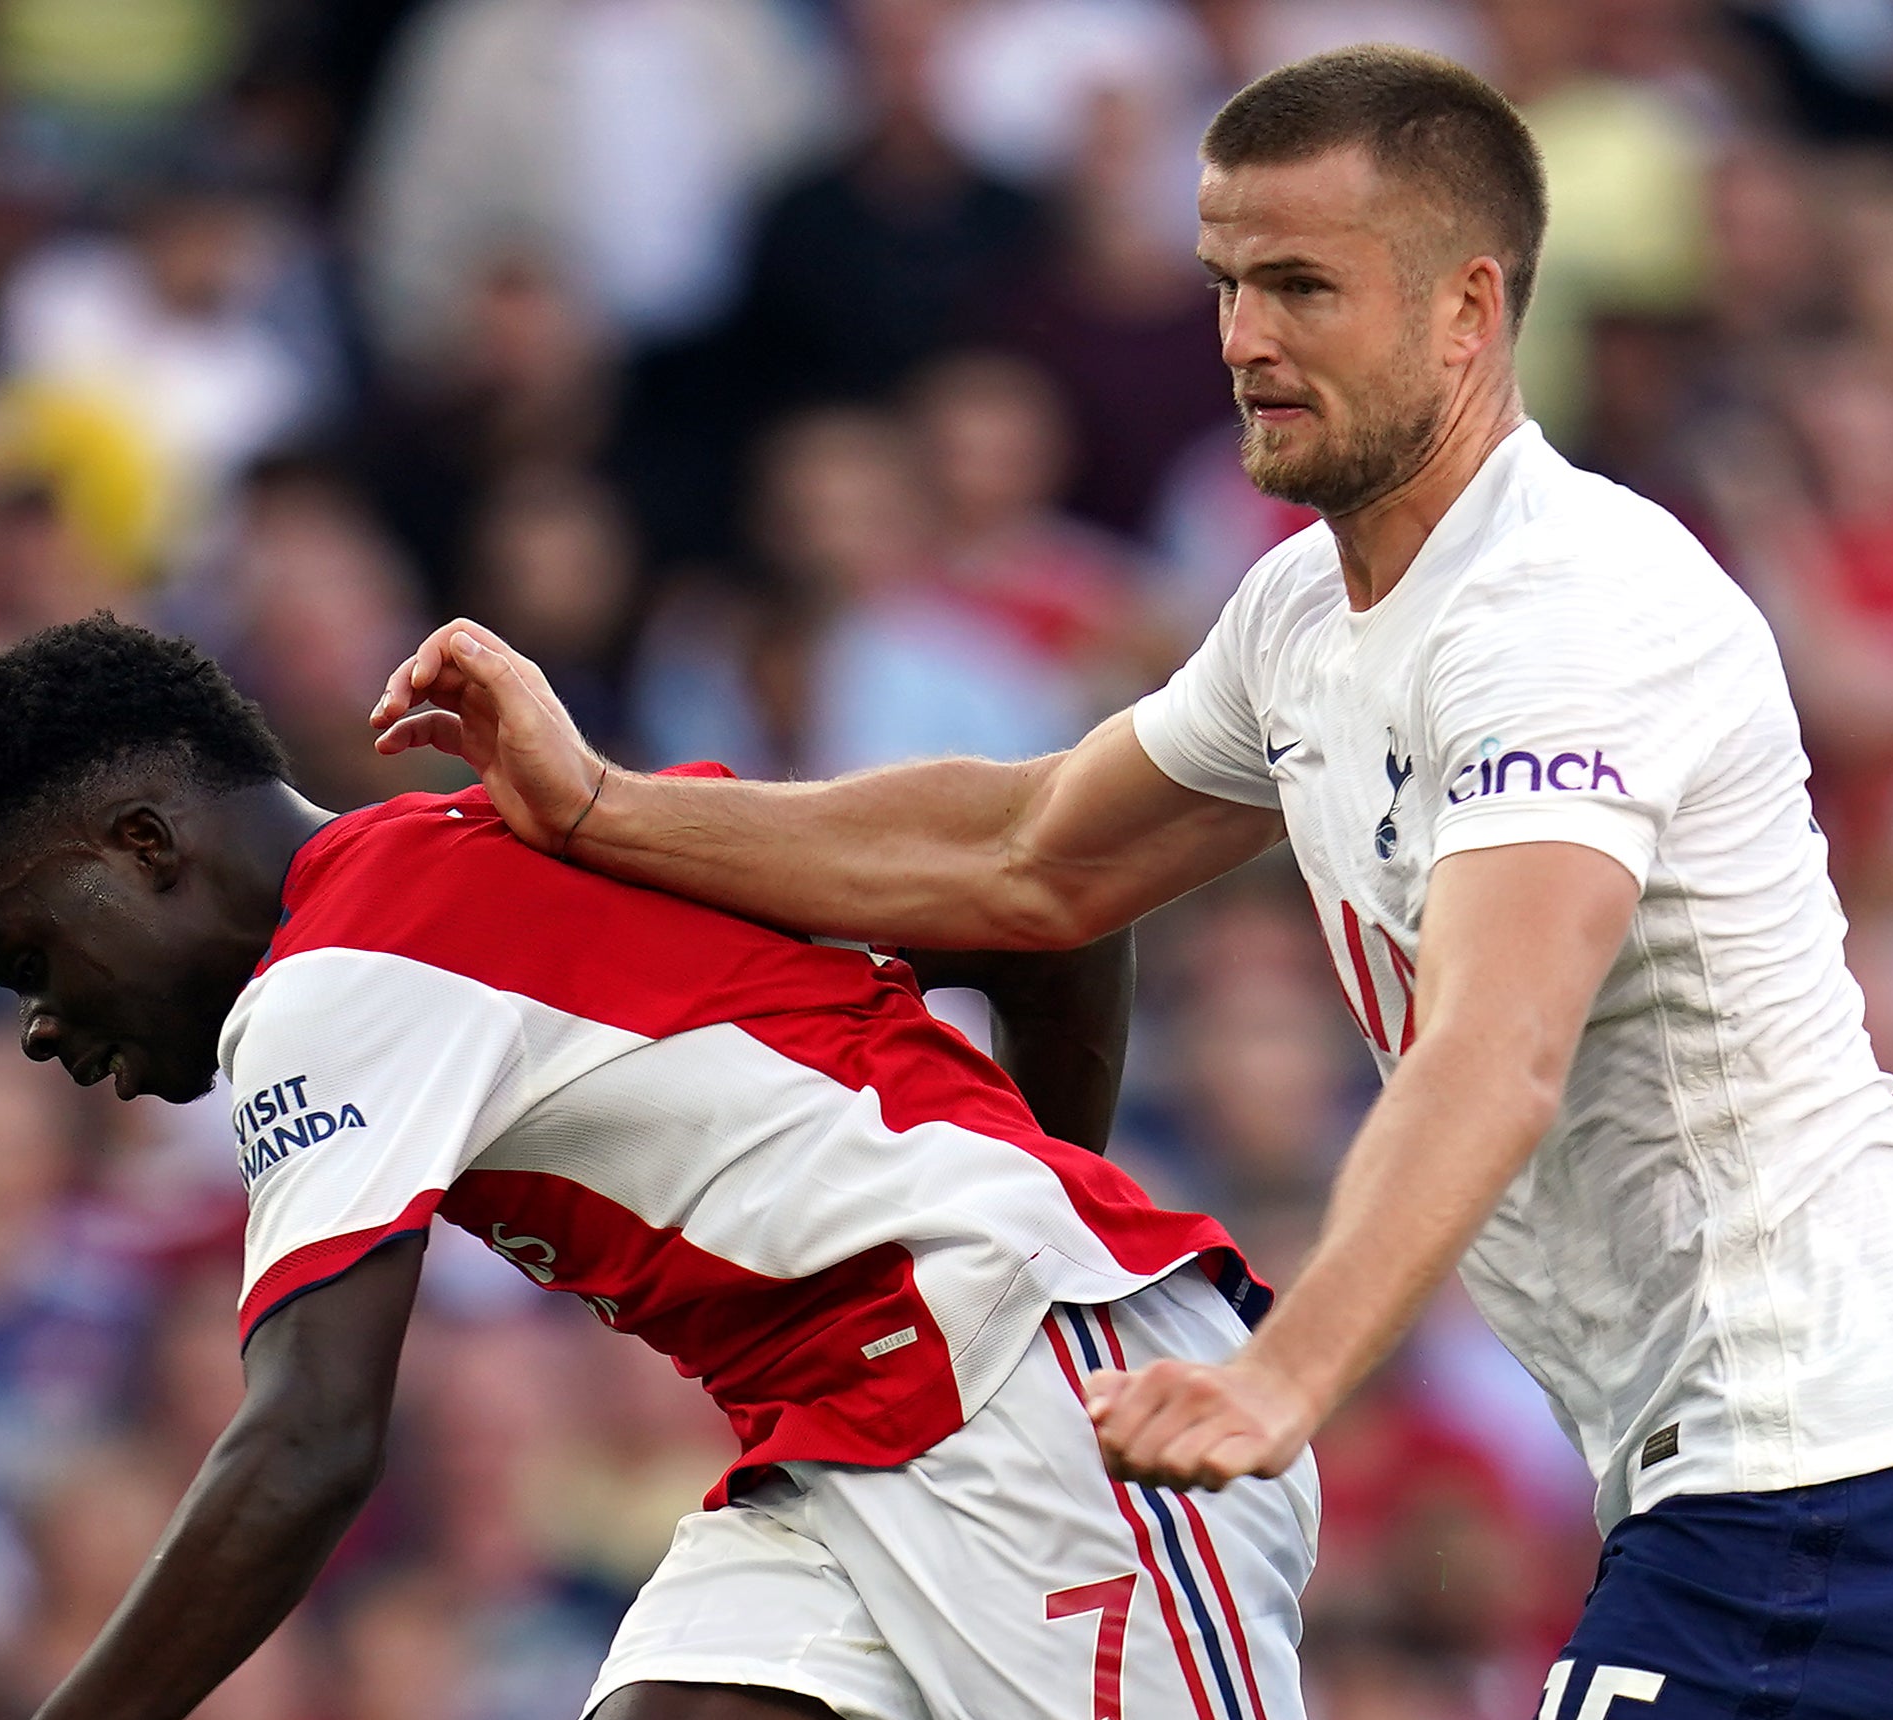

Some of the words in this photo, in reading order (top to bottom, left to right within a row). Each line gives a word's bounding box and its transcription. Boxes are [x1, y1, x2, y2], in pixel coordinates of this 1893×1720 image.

[1448, 737, 1635, 805] cinch
[233, 1075, 307, 1145] VISIT
[239, 1103, 367, 1190] WANDA
